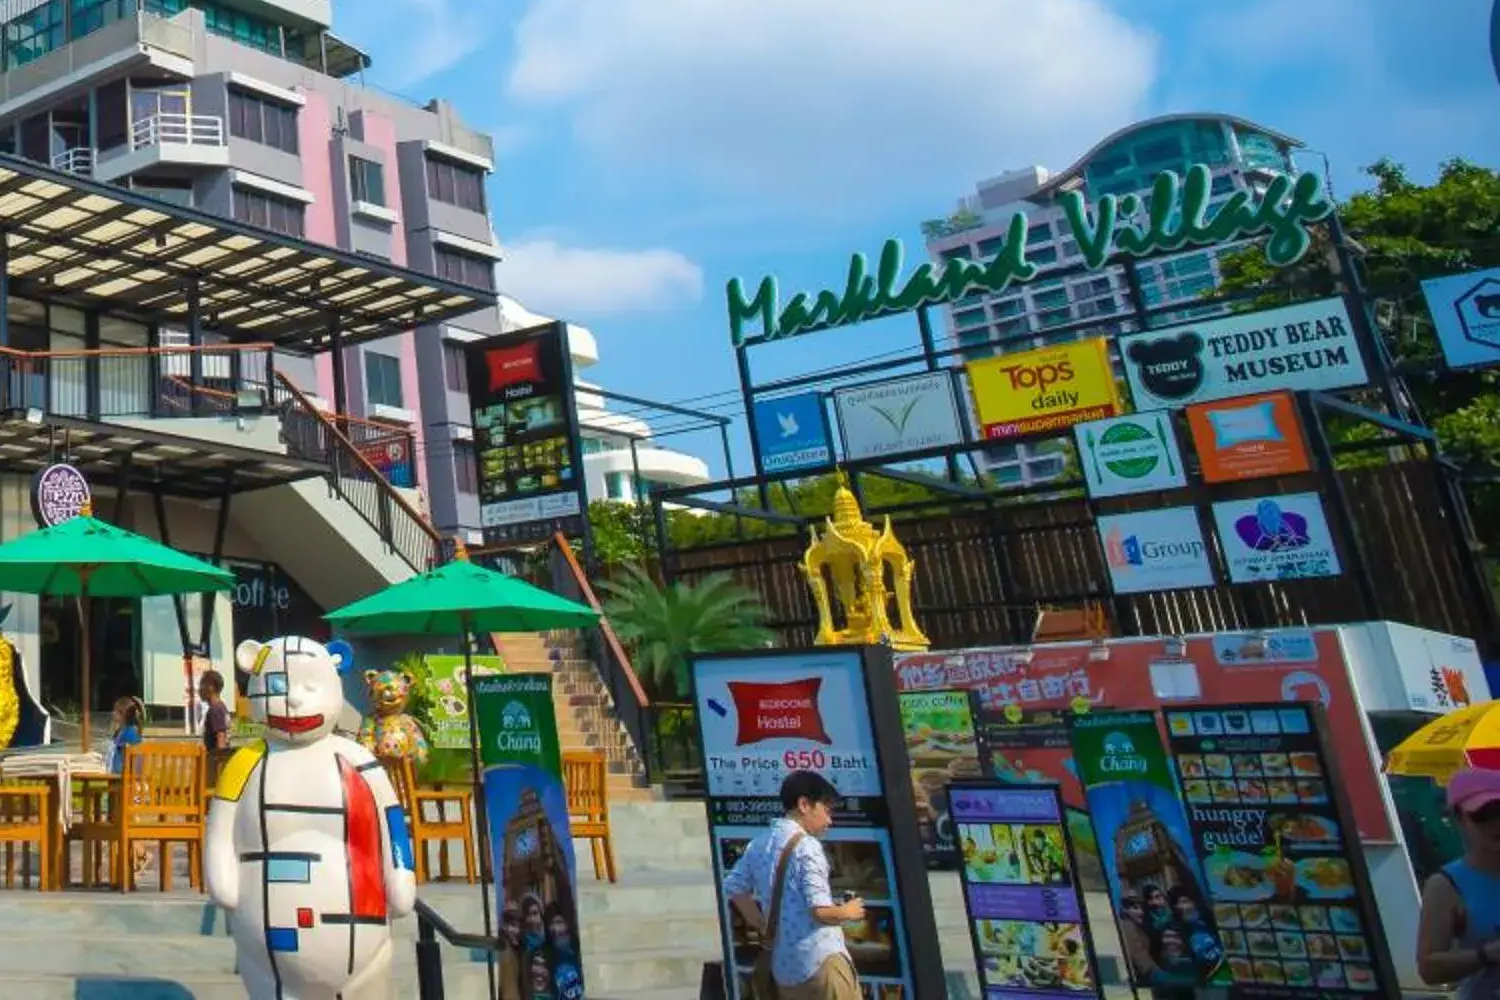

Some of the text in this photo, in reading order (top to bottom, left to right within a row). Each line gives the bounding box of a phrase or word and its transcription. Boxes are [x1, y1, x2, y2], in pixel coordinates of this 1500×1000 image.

[727, 163, 1336, 346] Markland Village
[1207, 315, 1348, 358] TEDDY BEAR
[1146, 359, 1189, 376] TEDDY
[1224, 346, 1349, 382] MUSEUM
[1000, 361, 1075, 393] Tops
[1031, 390, 1080, 410] daily
[1142, 538, 1204, 560] Group
[757, 714, 802, 730] Hostel
[497, 731, 542, 754] Chang
[709, 757, 736, 770] The
[741, 756, 780, 770] Price
[784, 750, 826, 771] 650
[1100, 754, 1148, 775] Chang
[1192, 805, 1268, 830] hungry
[1202, 825, 1265, 851] guide!
